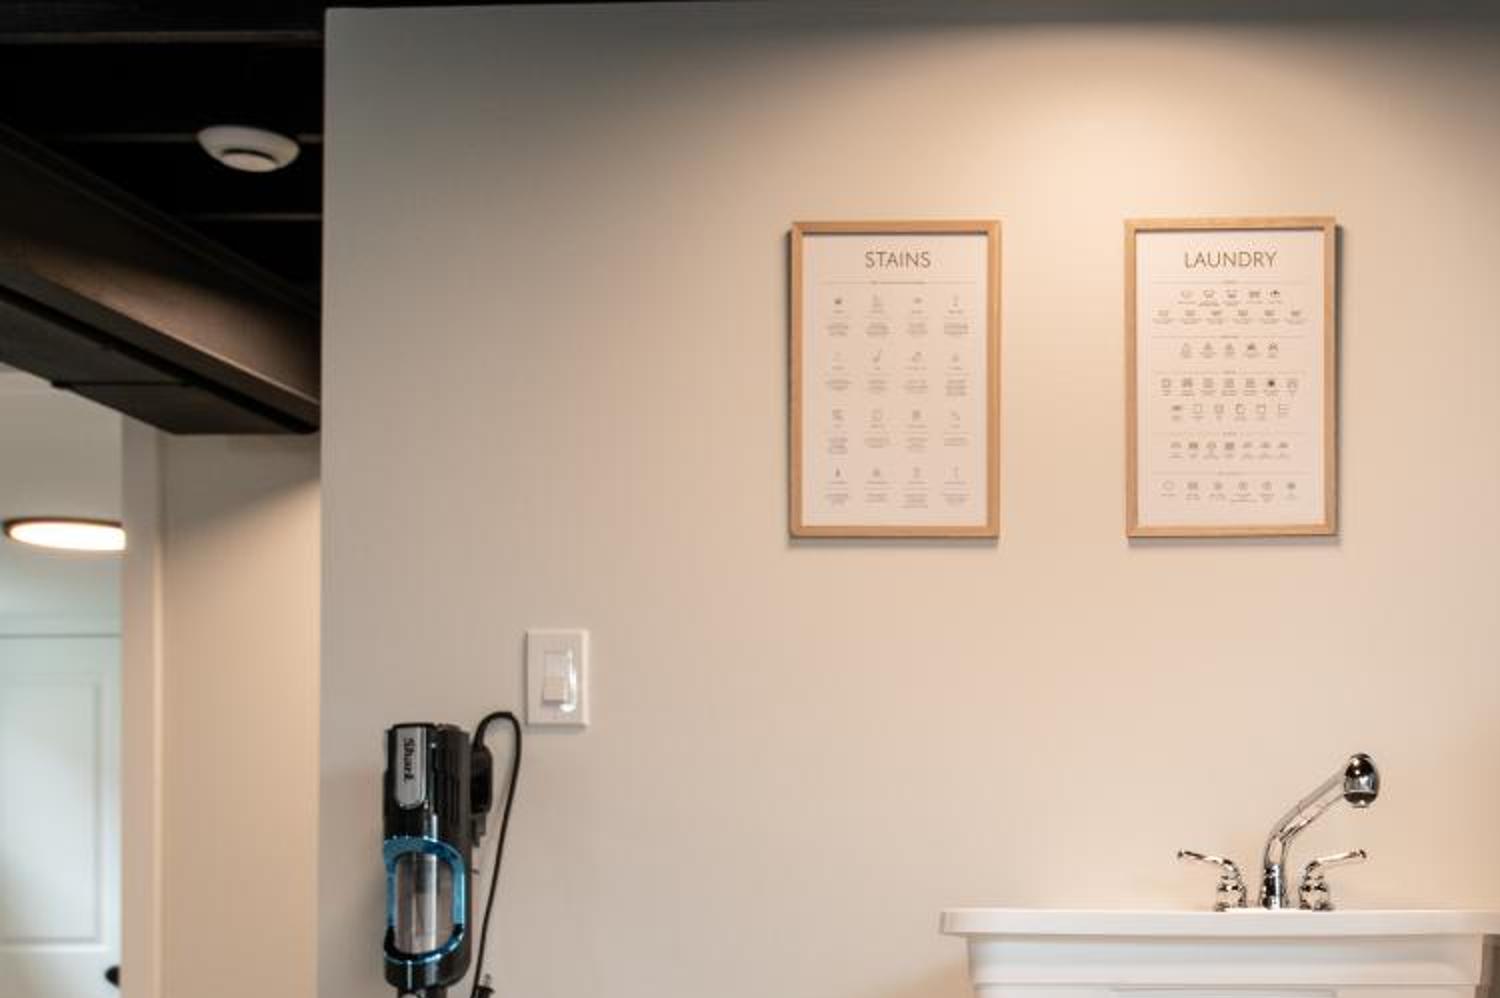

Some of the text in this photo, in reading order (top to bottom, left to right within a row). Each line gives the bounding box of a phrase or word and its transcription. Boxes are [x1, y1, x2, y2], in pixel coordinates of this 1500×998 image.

[865, 251, 931, 269] STAINS
[1184, 251, 1277, 269] LAUNDRY
[403, 737, 416, 784] Shark
